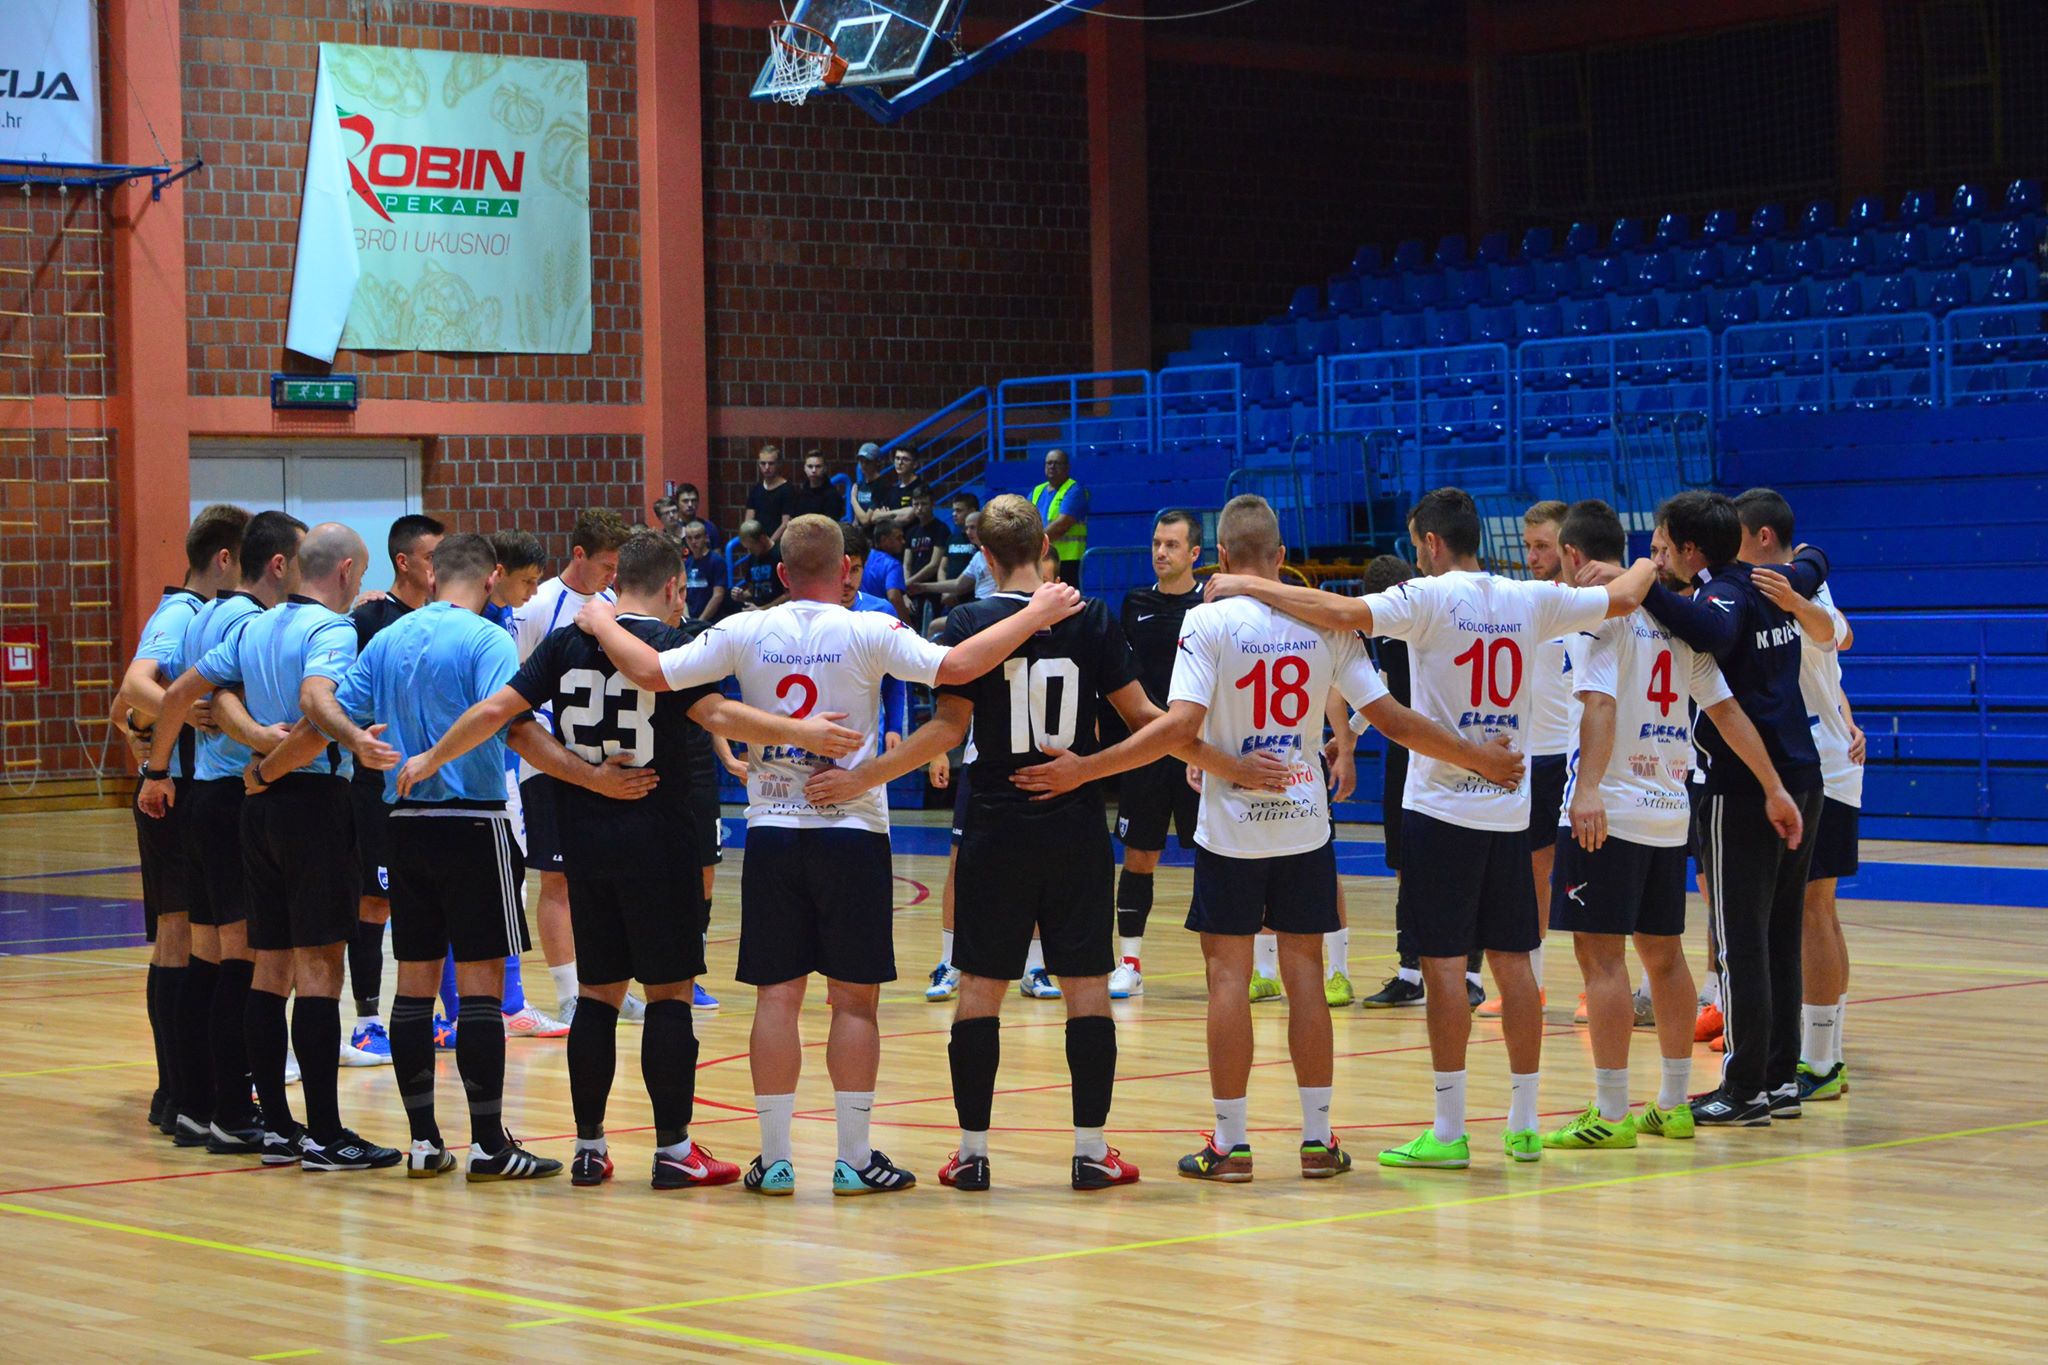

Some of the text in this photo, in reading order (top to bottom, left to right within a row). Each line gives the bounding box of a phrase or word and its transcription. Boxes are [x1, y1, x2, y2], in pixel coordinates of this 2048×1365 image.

[338, 113, 525, 223] ROBIN
[385, 195, 513, 215] PEKARA
[402, 230, 409, 250] I
[414, 231, 512, 256] UKUSNO!
[775, 673, 818, 720] 2
[1003, 657, 1080, 754] 10
[1235, 655, 1310, 730] 18
[1453, 637, 1523, 708] 10
[1647, 650, 1678, 718] 4
[559, 668, 656, 768] 23
[1251, 798, 1311, 809] PEKARA
